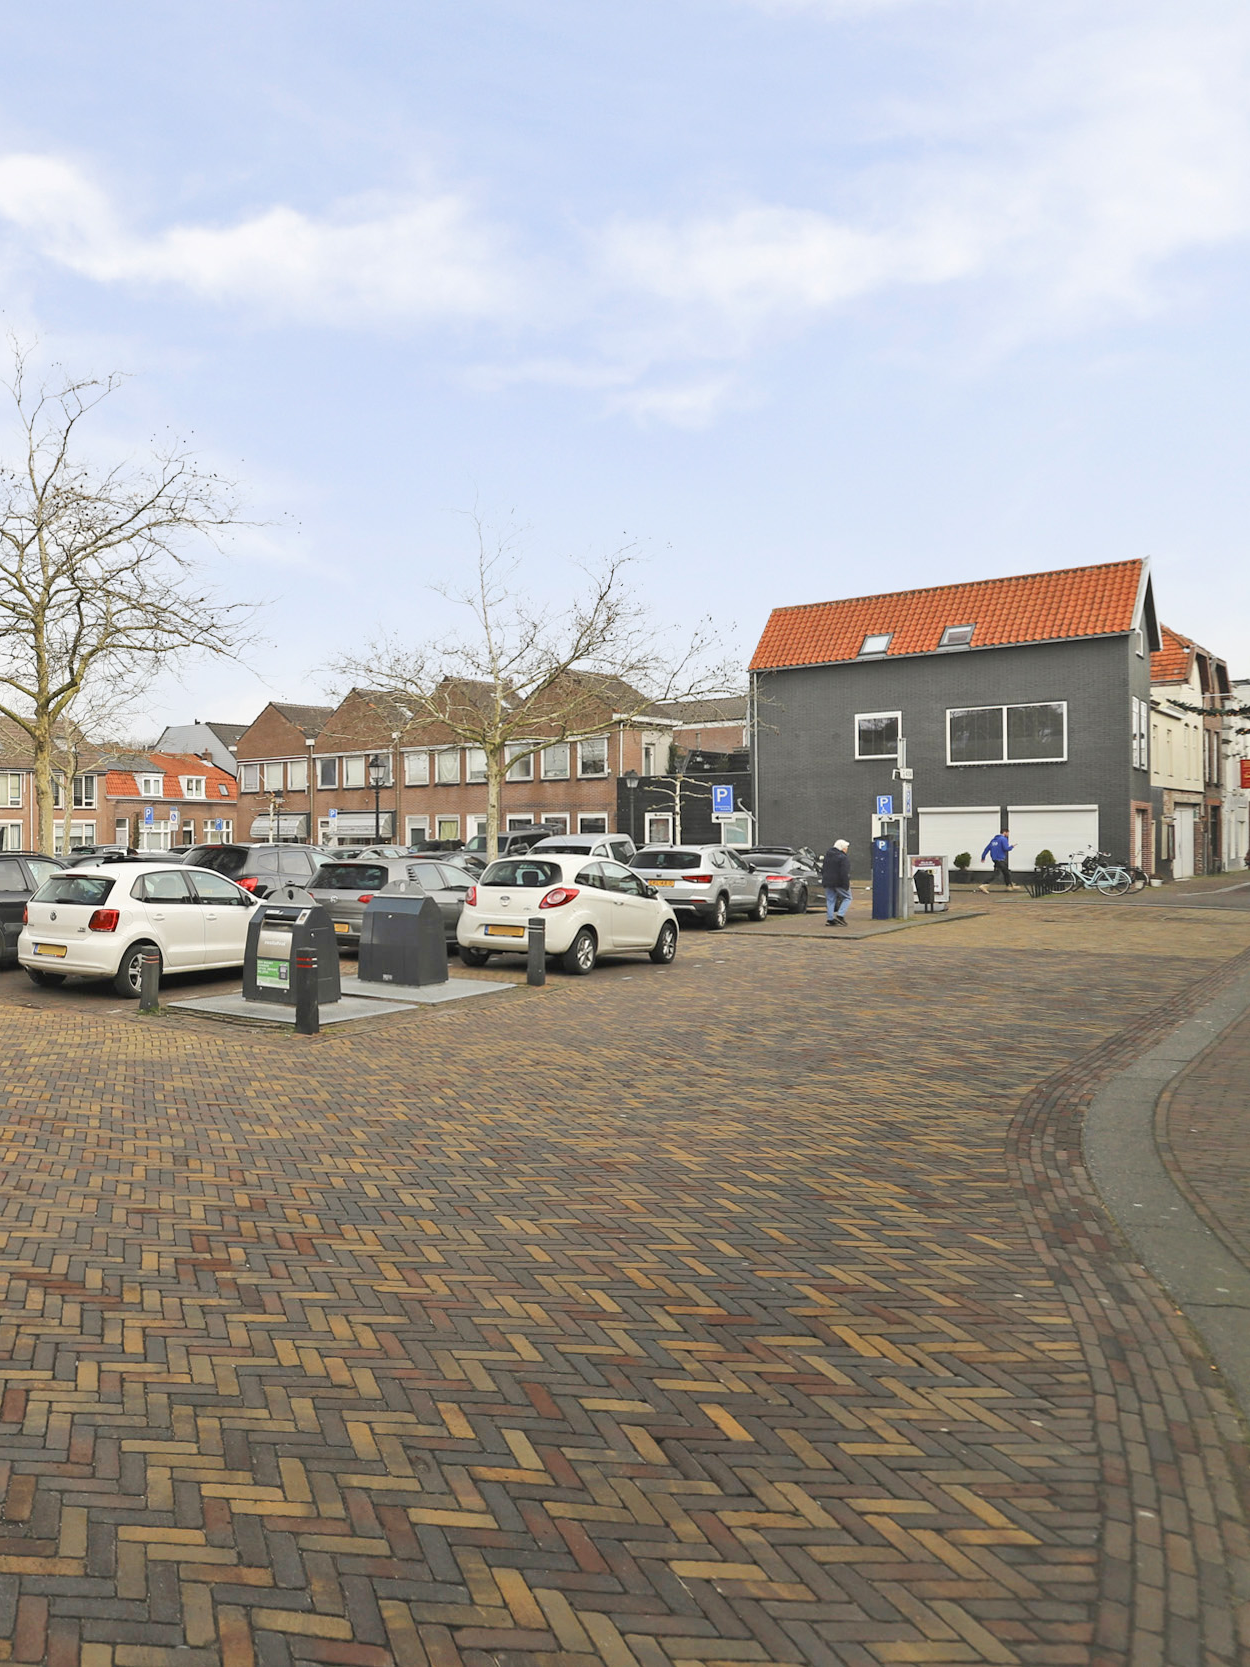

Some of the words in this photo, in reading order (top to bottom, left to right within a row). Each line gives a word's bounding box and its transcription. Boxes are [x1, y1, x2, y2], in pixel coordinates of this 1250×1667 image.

[716, 788, 728, 802] P
[880, 797, 889, 807] P
[878, 840, 886, 849] P
